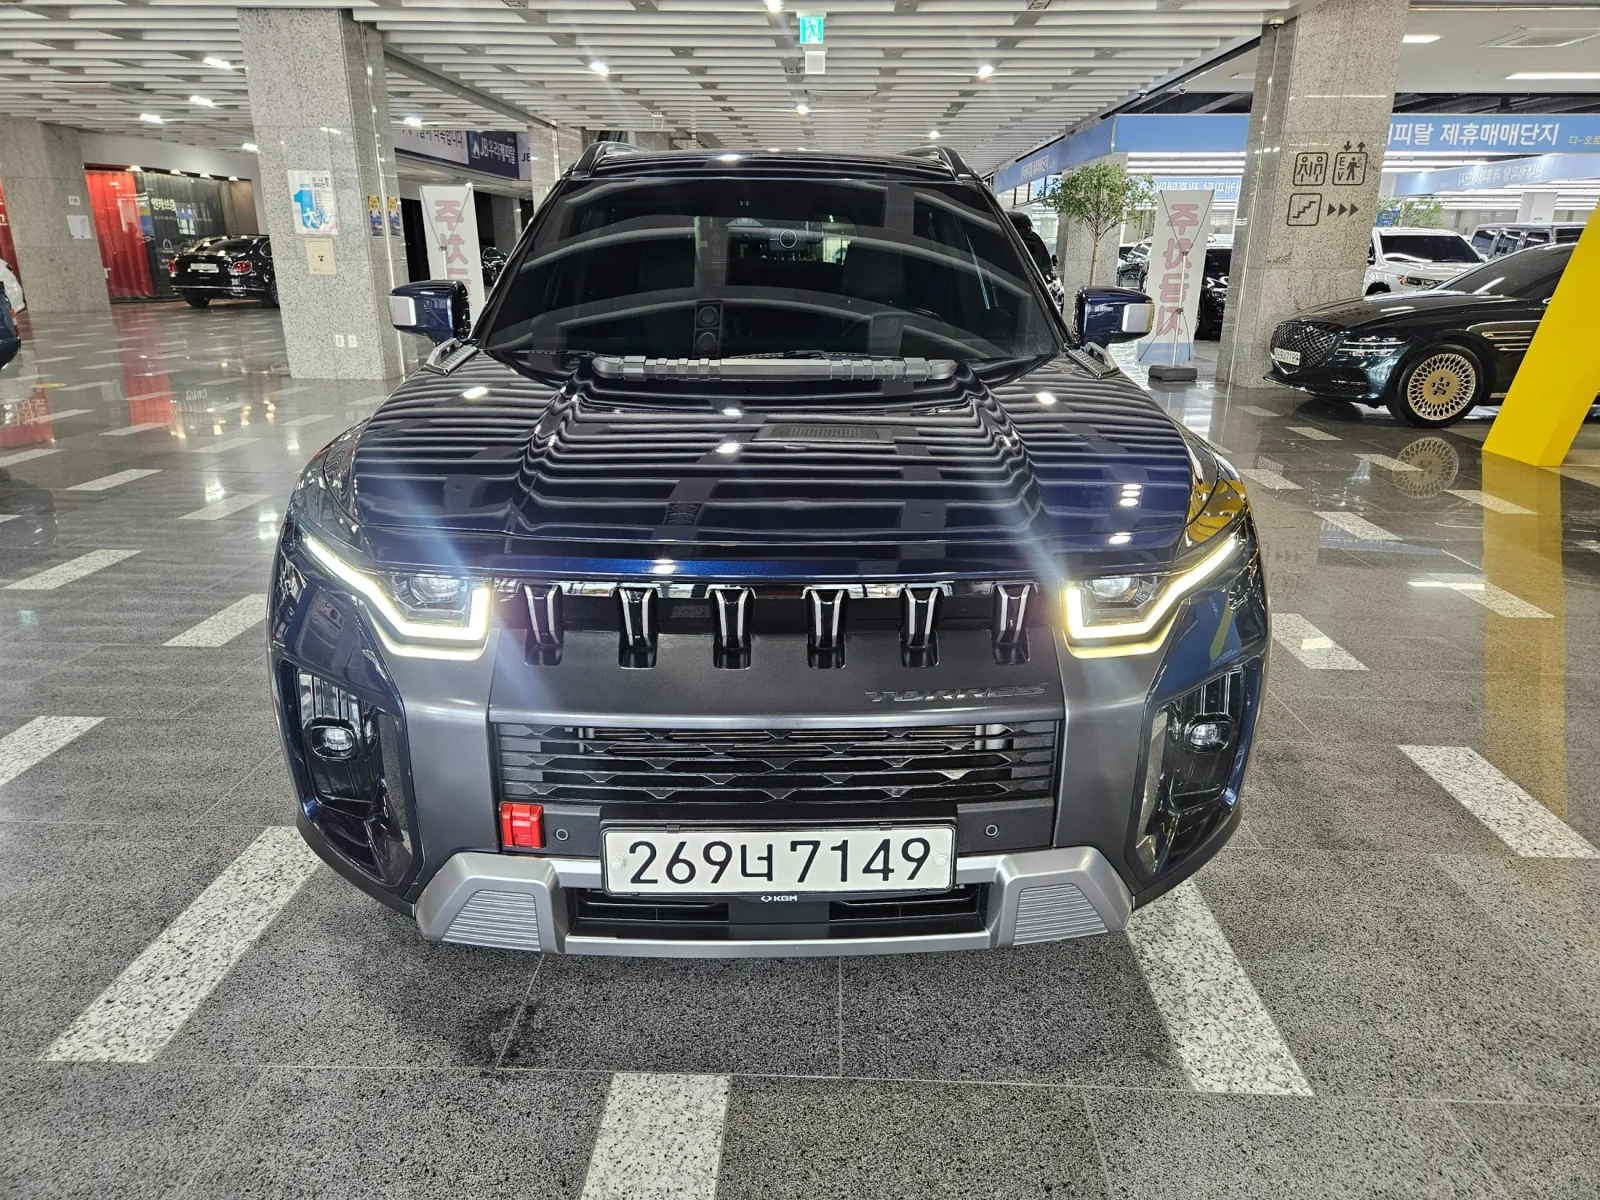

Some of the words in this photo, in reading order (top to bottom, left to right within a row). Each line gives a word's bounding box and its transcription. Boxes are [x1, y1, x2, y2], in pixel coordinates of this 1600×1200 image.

[1386, 122, 1434, 146] 피탈
[1439, 122, 1560, 146] 제휴매매단지
[864, 683, 1050, 703] TORRES
[773, 894, 798, 902] KGM
